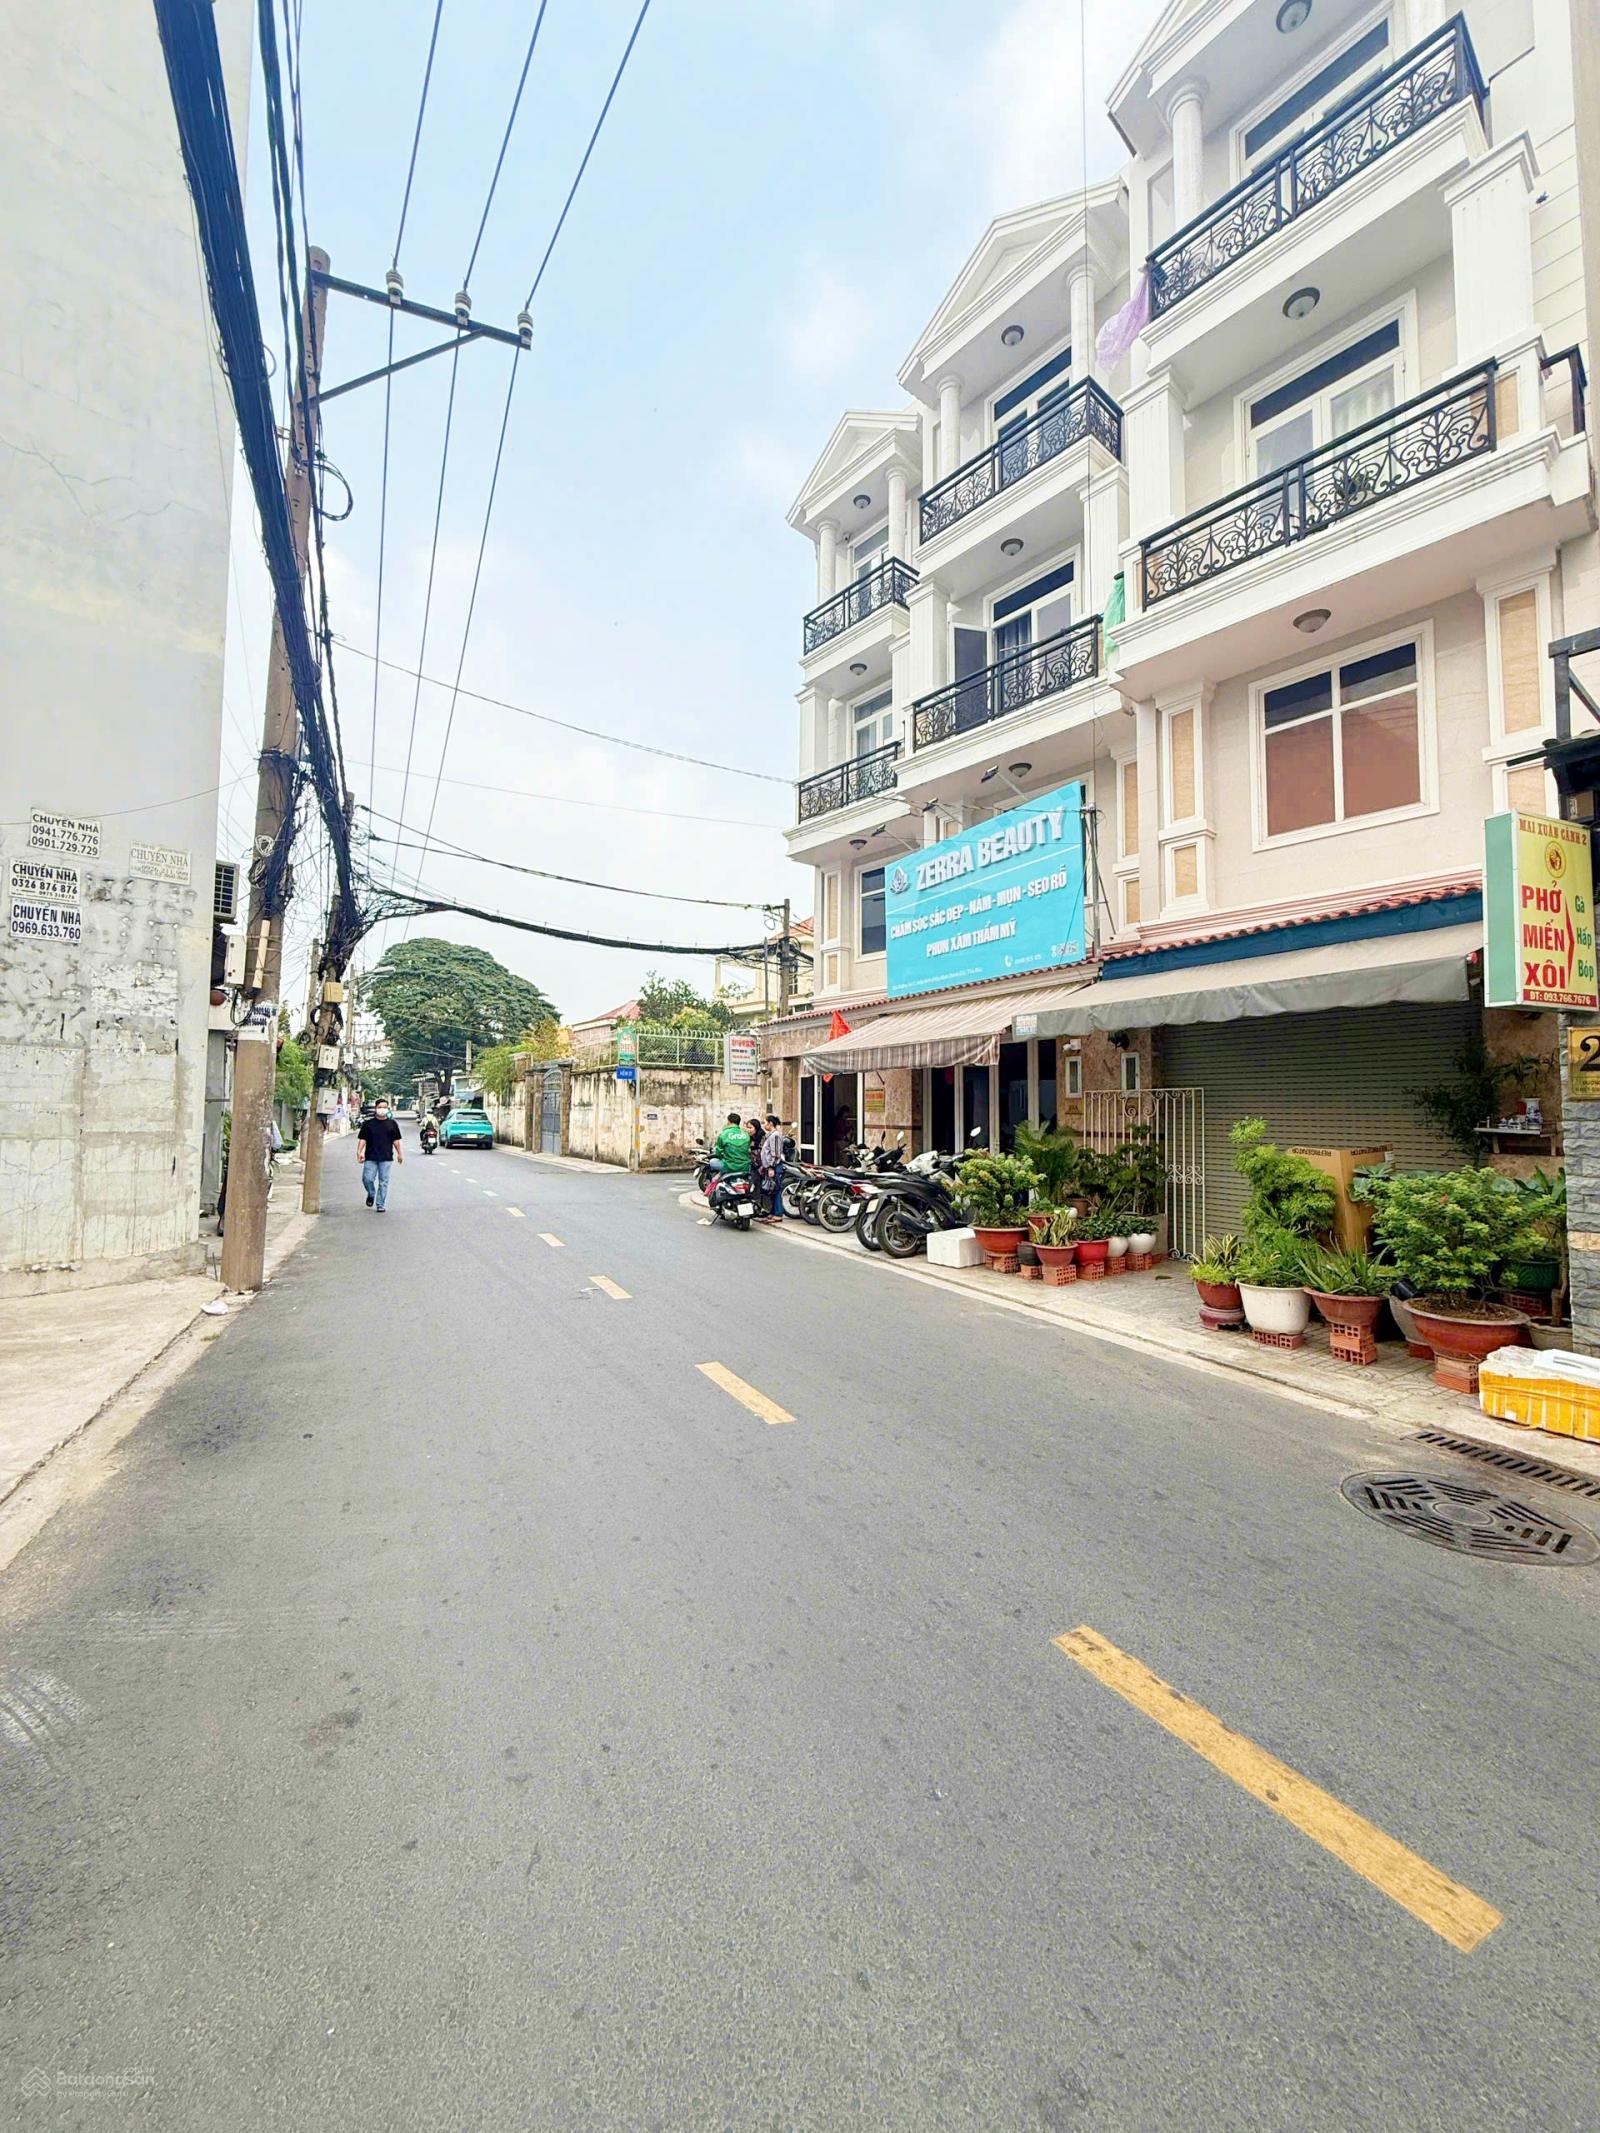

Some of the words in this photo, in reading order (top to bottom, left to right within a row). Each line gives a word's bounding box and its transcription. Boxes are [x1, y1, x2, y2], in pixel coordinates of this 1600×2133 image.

[33, 825, 98, 845] 0941.776.776
[1519, 819, 1535, 833] MAI
[1582, 834, 1587, 846] 2
[32, 836, 98, 856] 0901.729.729
[917, 846, 975, 891] ZERRA
[977, 806, 1066, 868] BEAUTY
[12, 878, 36, 889] 0326
[40, 882, 57, 892] 876
[61, 885, 78, 894] 876
[997, 886, 1022, 909] MỤN
[1027, 876, 1050, 900] SẸO
[1522, 880, 1562, 914] PHỞ
[1575, 895, 1585, 914] Gà
[12, 920, 81, 940] 0969.633.760
[1523, 919, 1565, 952] MIẾN
[1576, 926, 1592, 949] Hấp
[1524, 959, 1566, 989] XÔI
[1578, 959, 1594, 982] Bóp
[728, 1132, 747, 1140] Grab
[1292, 1147, 1332, 1157] REFRIGERATOR
